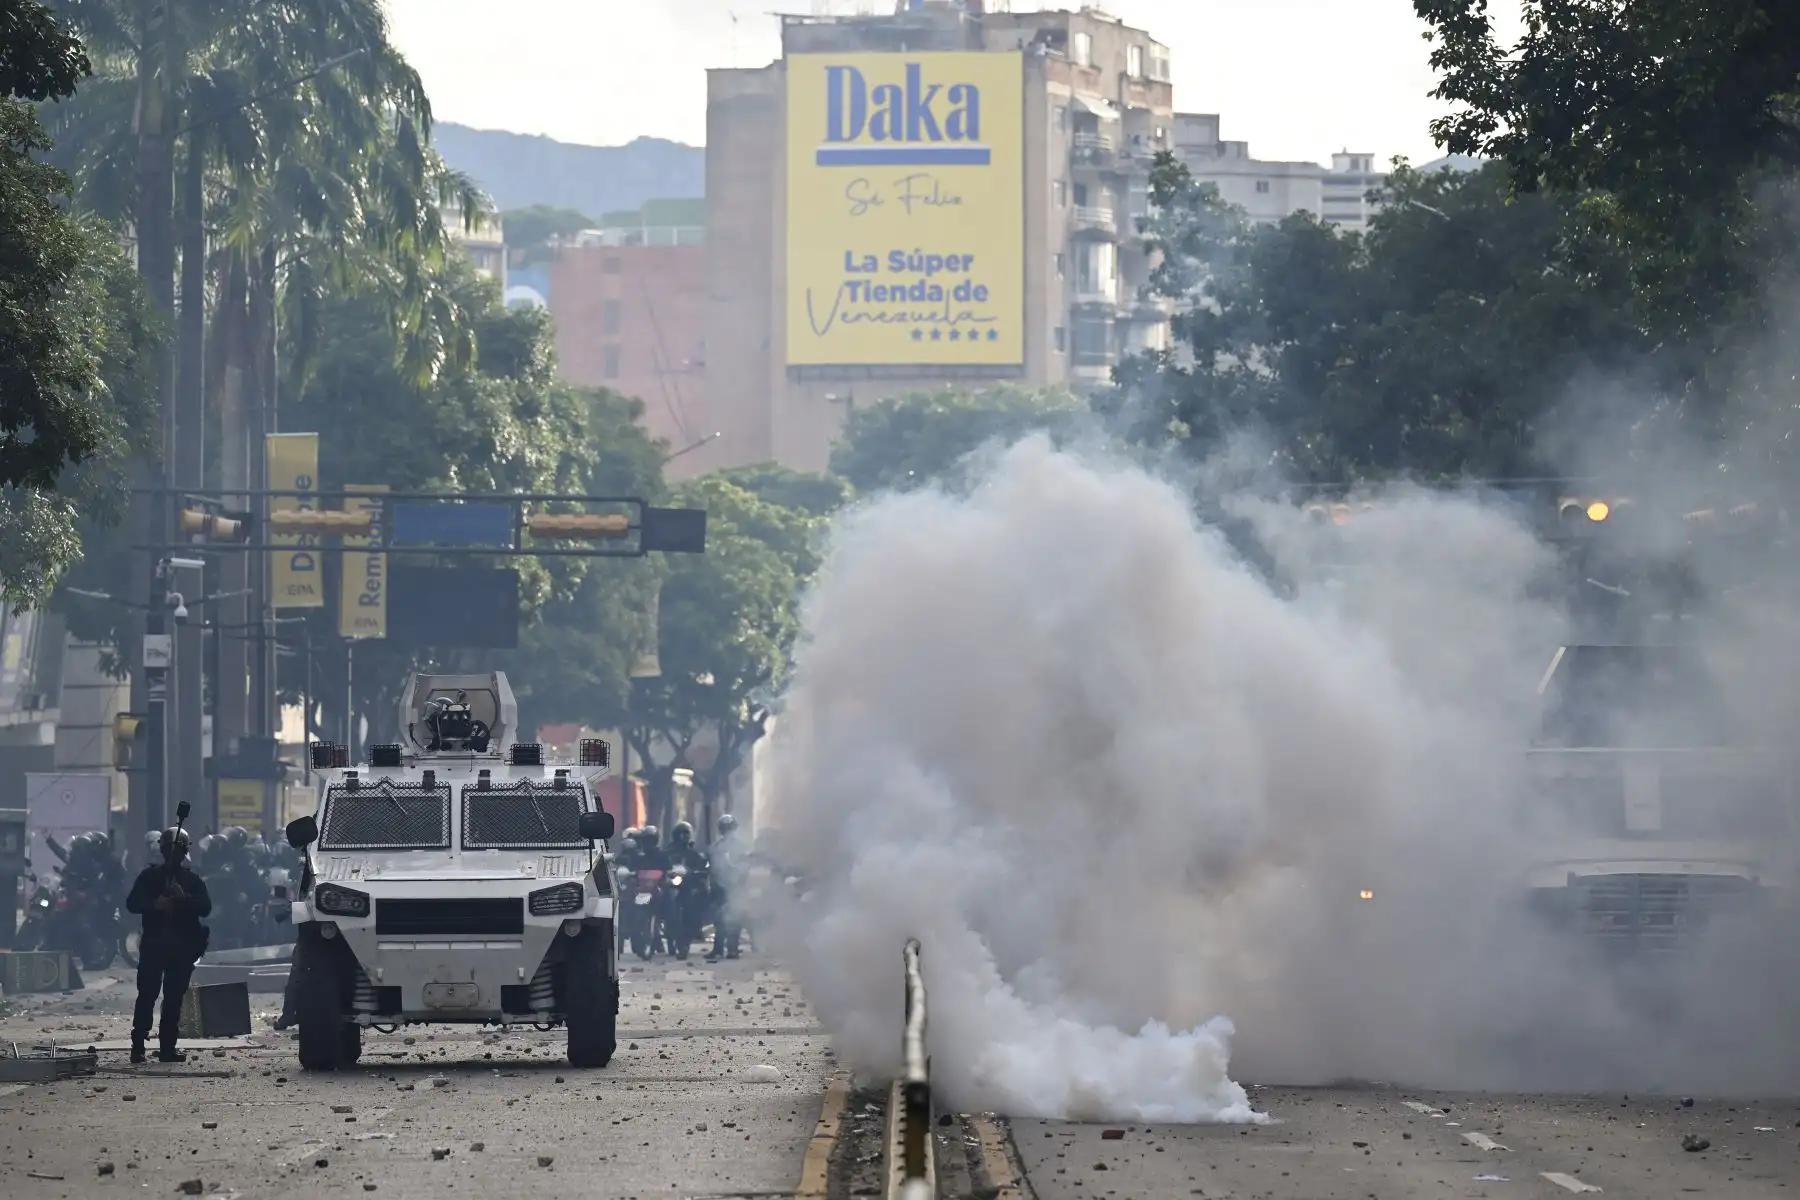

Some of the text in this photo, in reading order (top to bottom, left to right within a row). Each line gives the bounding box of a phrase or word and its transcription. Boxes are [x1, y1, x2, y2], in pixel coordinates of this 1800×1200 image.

[822, 62, 981, 142] Daka
[844, 248, 974, 277] La Súper
[844, 279, 988, 303] Tienda de
[806, 287, 997, 337] Venezuela
